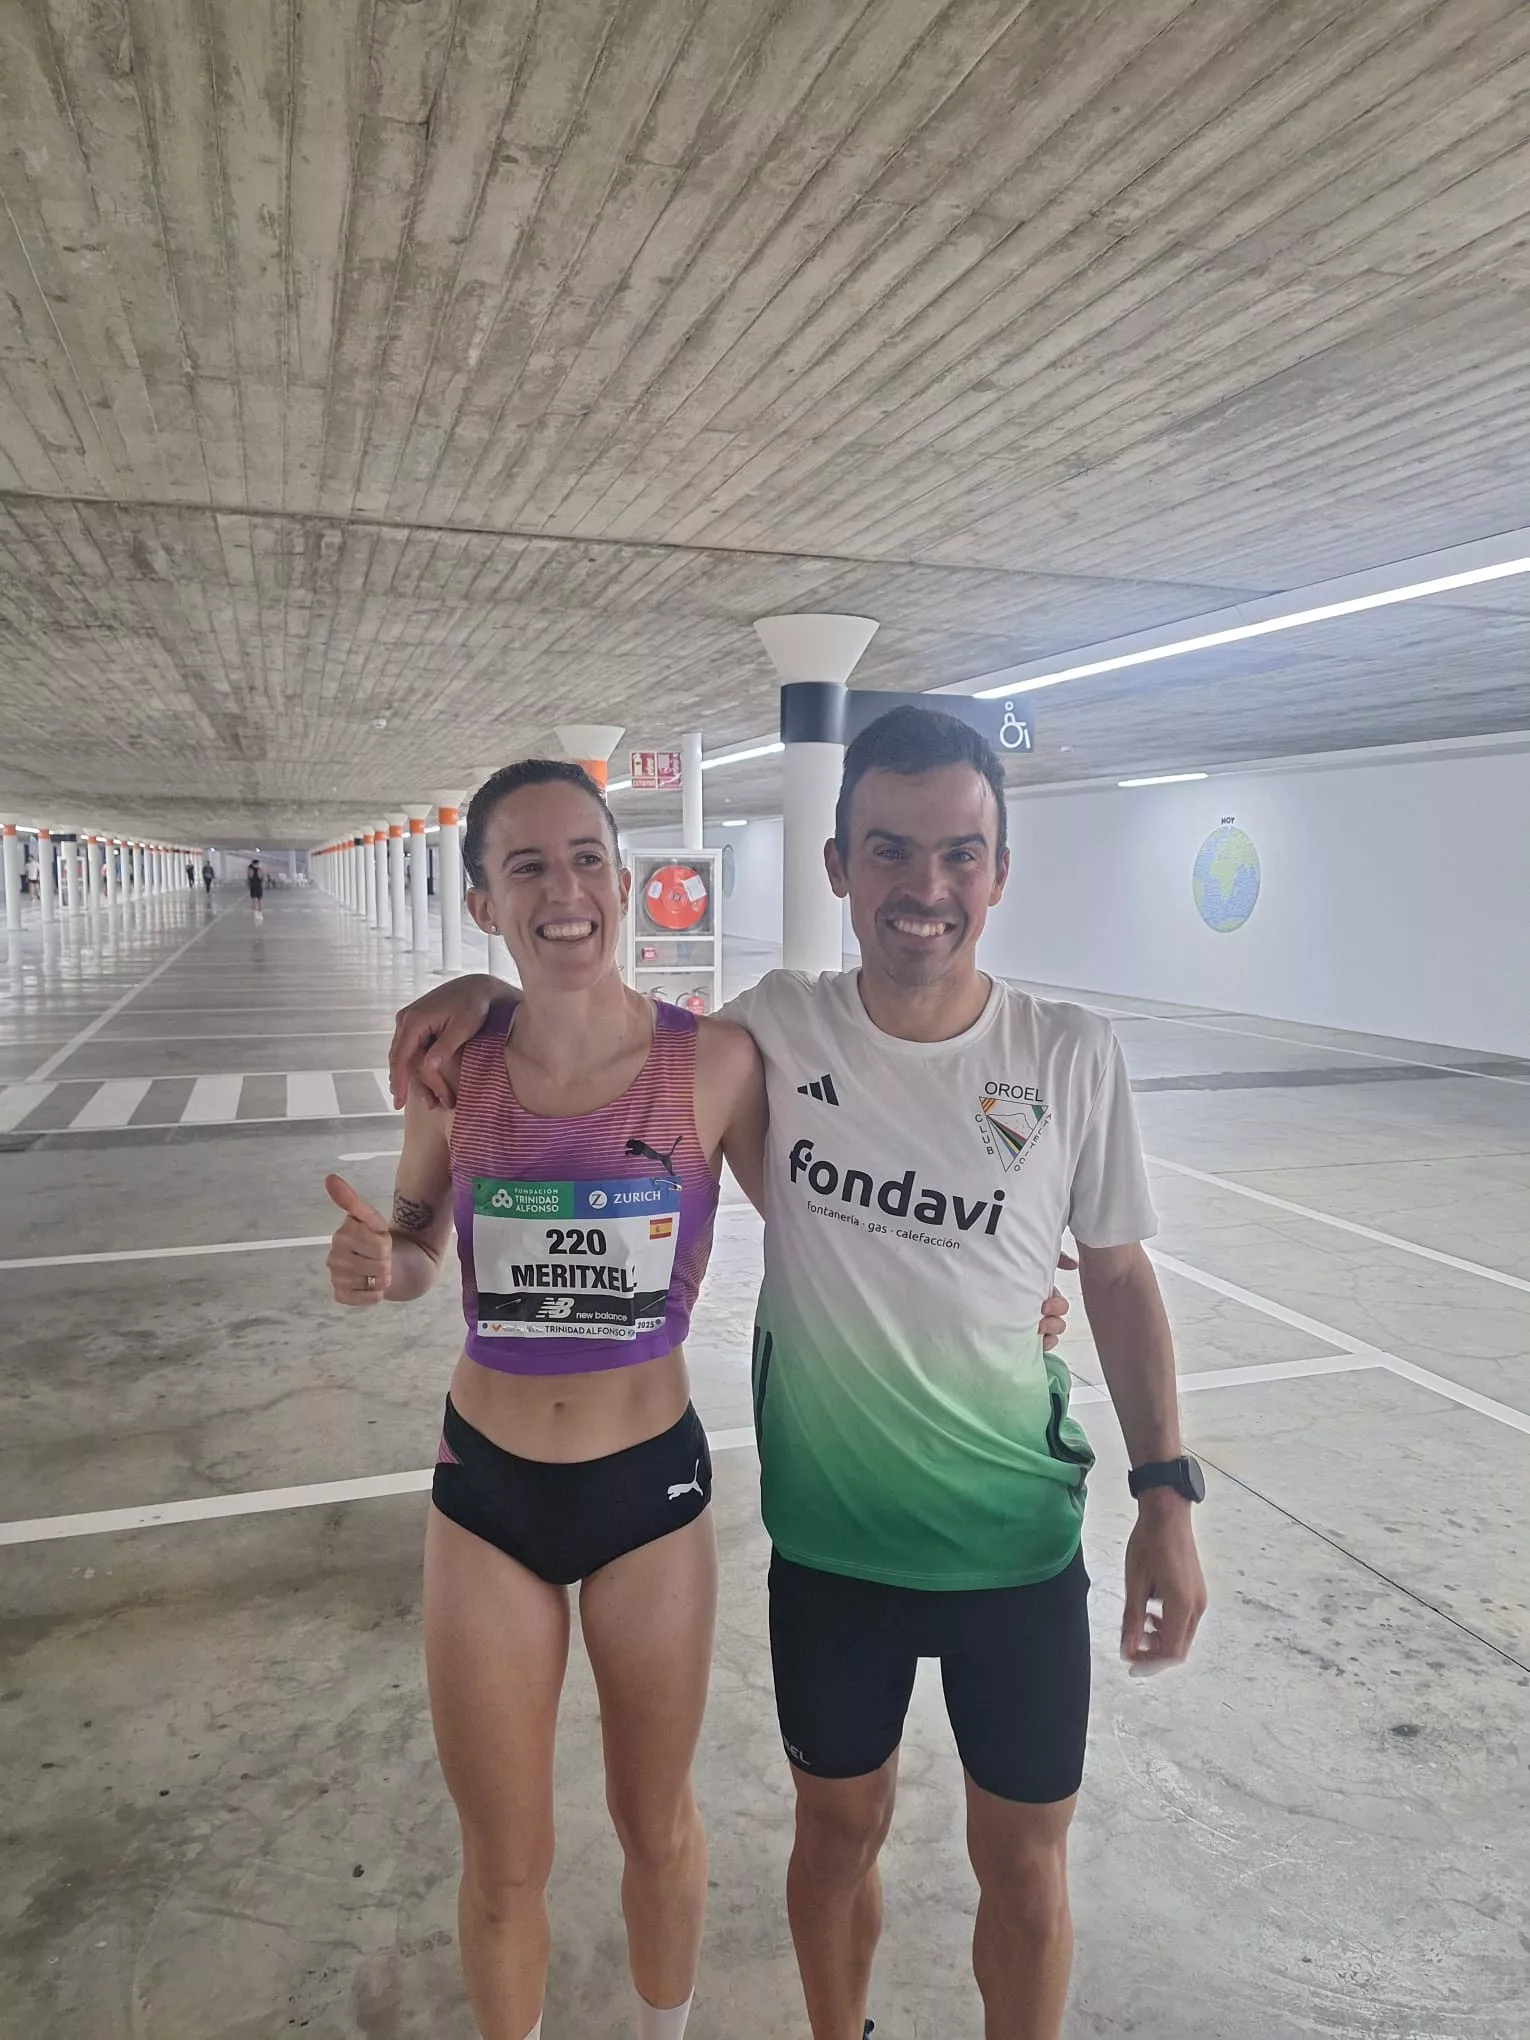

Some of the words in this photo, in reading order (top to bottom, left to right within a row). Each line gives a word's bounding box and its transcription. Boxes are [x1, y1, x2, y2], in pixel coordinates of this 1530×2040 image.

[1221, 816, 1235, 825] HOY
[985, 1081, 1044, 1102] OROEL
[975, 1114, 994, 1155] CLUB
[789, 1139, 1006, 1236] fondavi
[515, 1195, 559, 1204] TRINIDAD
[613, 1190, 661, 1205] ZURICH
[516, 1203, 559, 1213] ALFONSO
[546, 1228, 607, 1256] 220
[867, 1221, 888, 1234] gas
[896, 1228, 961, 1250] calefacción
[576, 1311, 592, 1320] new
[594, 1310, 628, 1322] balance
[545, 1325, 585, 1335] TRINIDAD
[585, 1326, 626, 1337] ALFONSO
[637, 1320, 655, 1329] 2025
